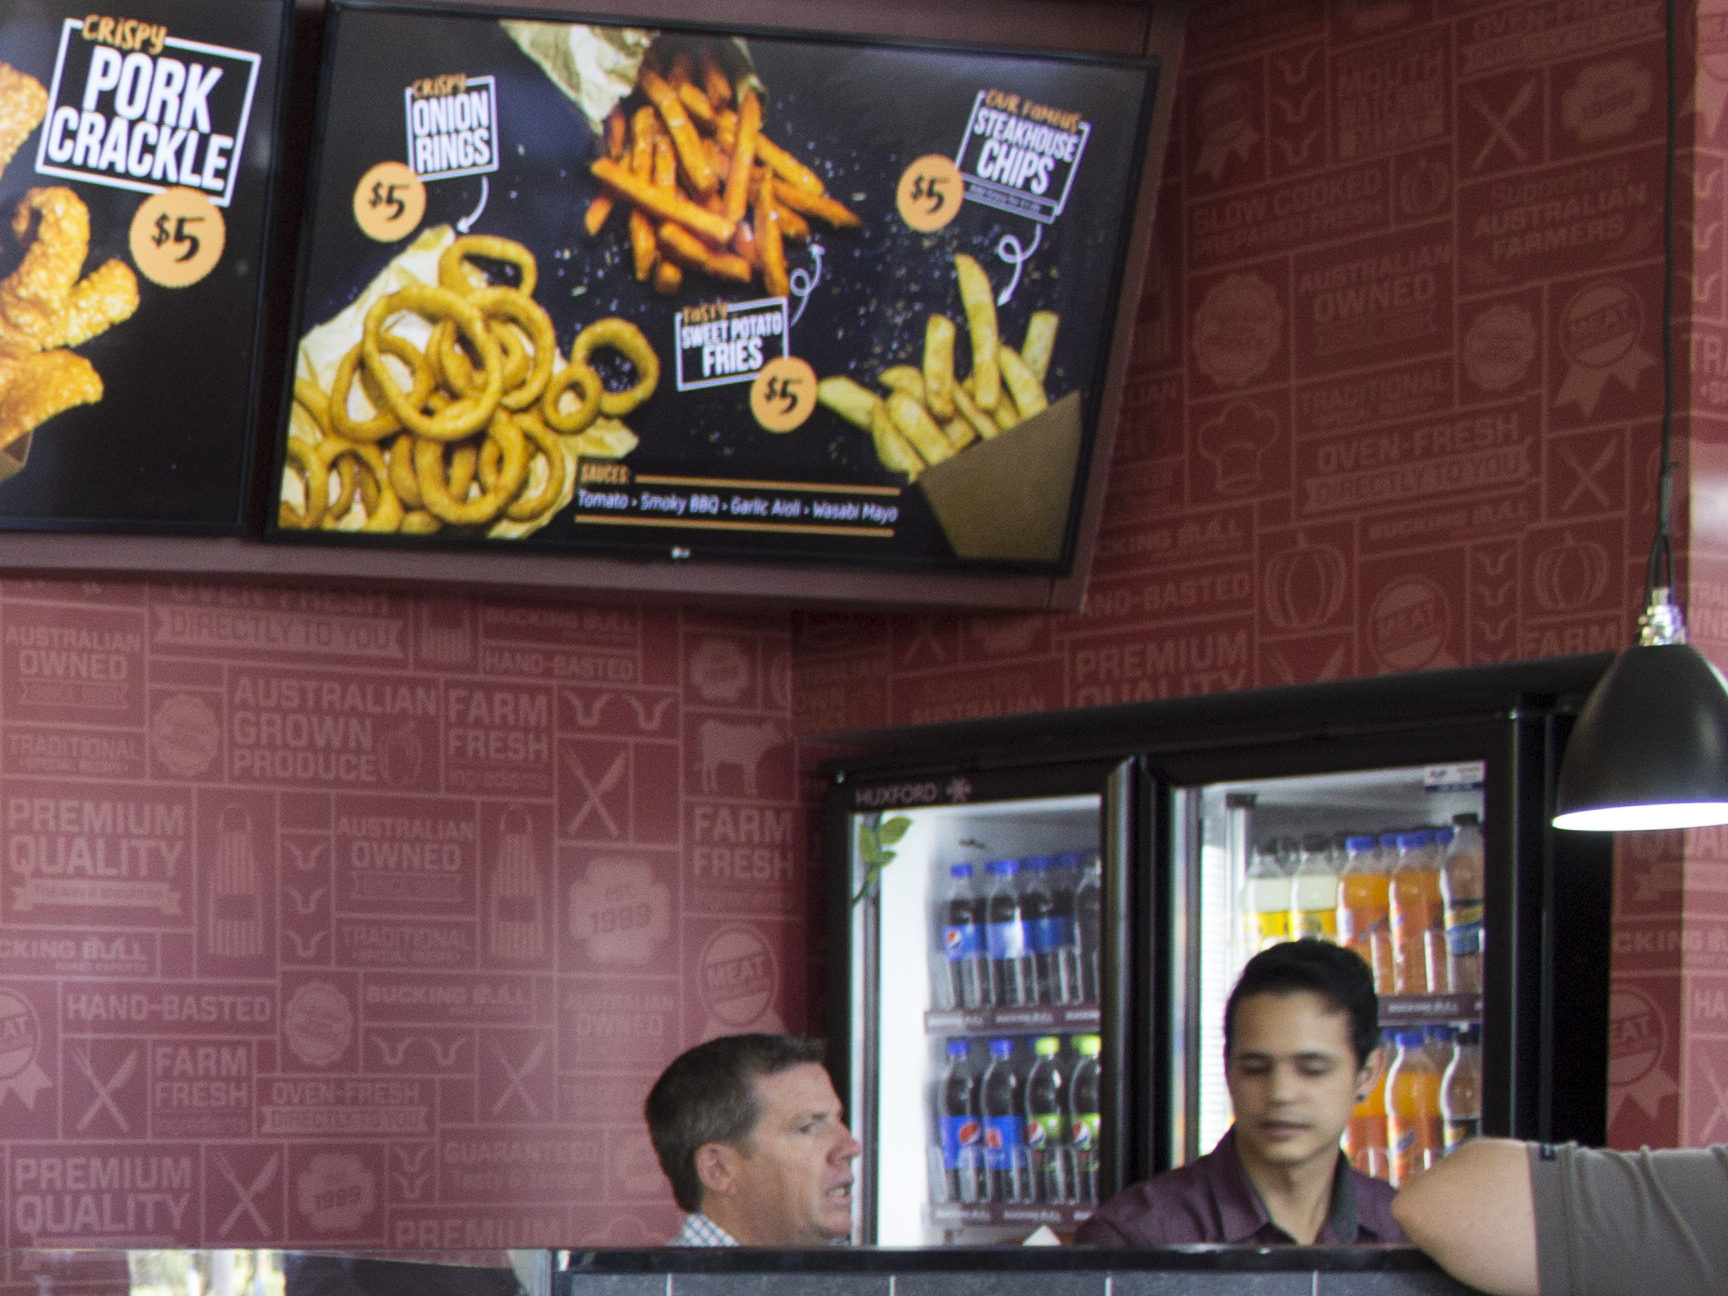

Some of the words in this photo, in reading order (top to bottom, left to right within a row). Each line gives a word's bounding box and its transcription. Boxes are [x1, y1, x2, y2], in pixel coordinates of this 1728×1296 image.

[82, 45, 224, 133] PORK
[413, 90, 490, 137] ONION
[48, 105, 234, 191] CRACKLE
[416, 128, 490, 174] RINGS
[974, 106, 1080, 163] STEAKHOUSE
[976, 138, 1056, 195] CHIPS
[368, 181, 411, 223] $5
[910, 174, 951, 214] $5
[151, 213, 205, 263] $5
[1314, 273, 1435, 322] OWNED
[681, 320, 729, 349] SWEET
[730, 311, 783, 340] POTATO
[702, 336, 763, 377] FRIES
[765, 376, 802, 415] $5
[1318, 414, 1519, 470] OVEN-FRESH
[577, 488, 628, 509] Tomato
[640, 493, 687, 515] Smoky
[690, 494, 718, 515] BBQ
[731, 496, 767, 517] Garlic
[771, 499, 801, 517] Aioli
[812, 501, 859, 520] Wasabi
[862, 502, 898, 525] Mayo
[5, 625, 141, 652] AUSTRALIAN
[1077, 631, 1248, 681] PREMIUM
[19, 650, 128, 680] OWNED
[485, 650, 634, 680] HAND-BASTED
[234, 676, 437, 716] AUSTRALIAN
[448, 689, 548, 726] FARM
[233, 712, 372, 750] GROWN
[448, 730, 548, 762] FRESH
[233, 749, 377, 781] PRODUCE
[856, 784, 936, 805] HUXFORD
[8, 798, 185, 836] PREMIUM
[339, 816, 473, 841] AUSTRALIAN
[693, 806, 791, 843] FARM
[8, 835, 186, 877] QUALITY
[351, 841, 461, 870] OWNED
[693, 849, 792, 879] FRESH
[82, 935, 148, 961] BULL
[708, 954, 765, 986] MEAT
[68, 995, 270, 1022] HAND-BASTED
[366, 984, 466, 1004] BUCKING
[155, 1047, 246, 1077] FARM
[155, 1082, 247, 1107] FRESH
[272, 1082, 420, 1103] OVEN-FRESH
[16, 1158, 191, 1191] PREMIUM
[17, 1194, 190, 1236] QUALITY
